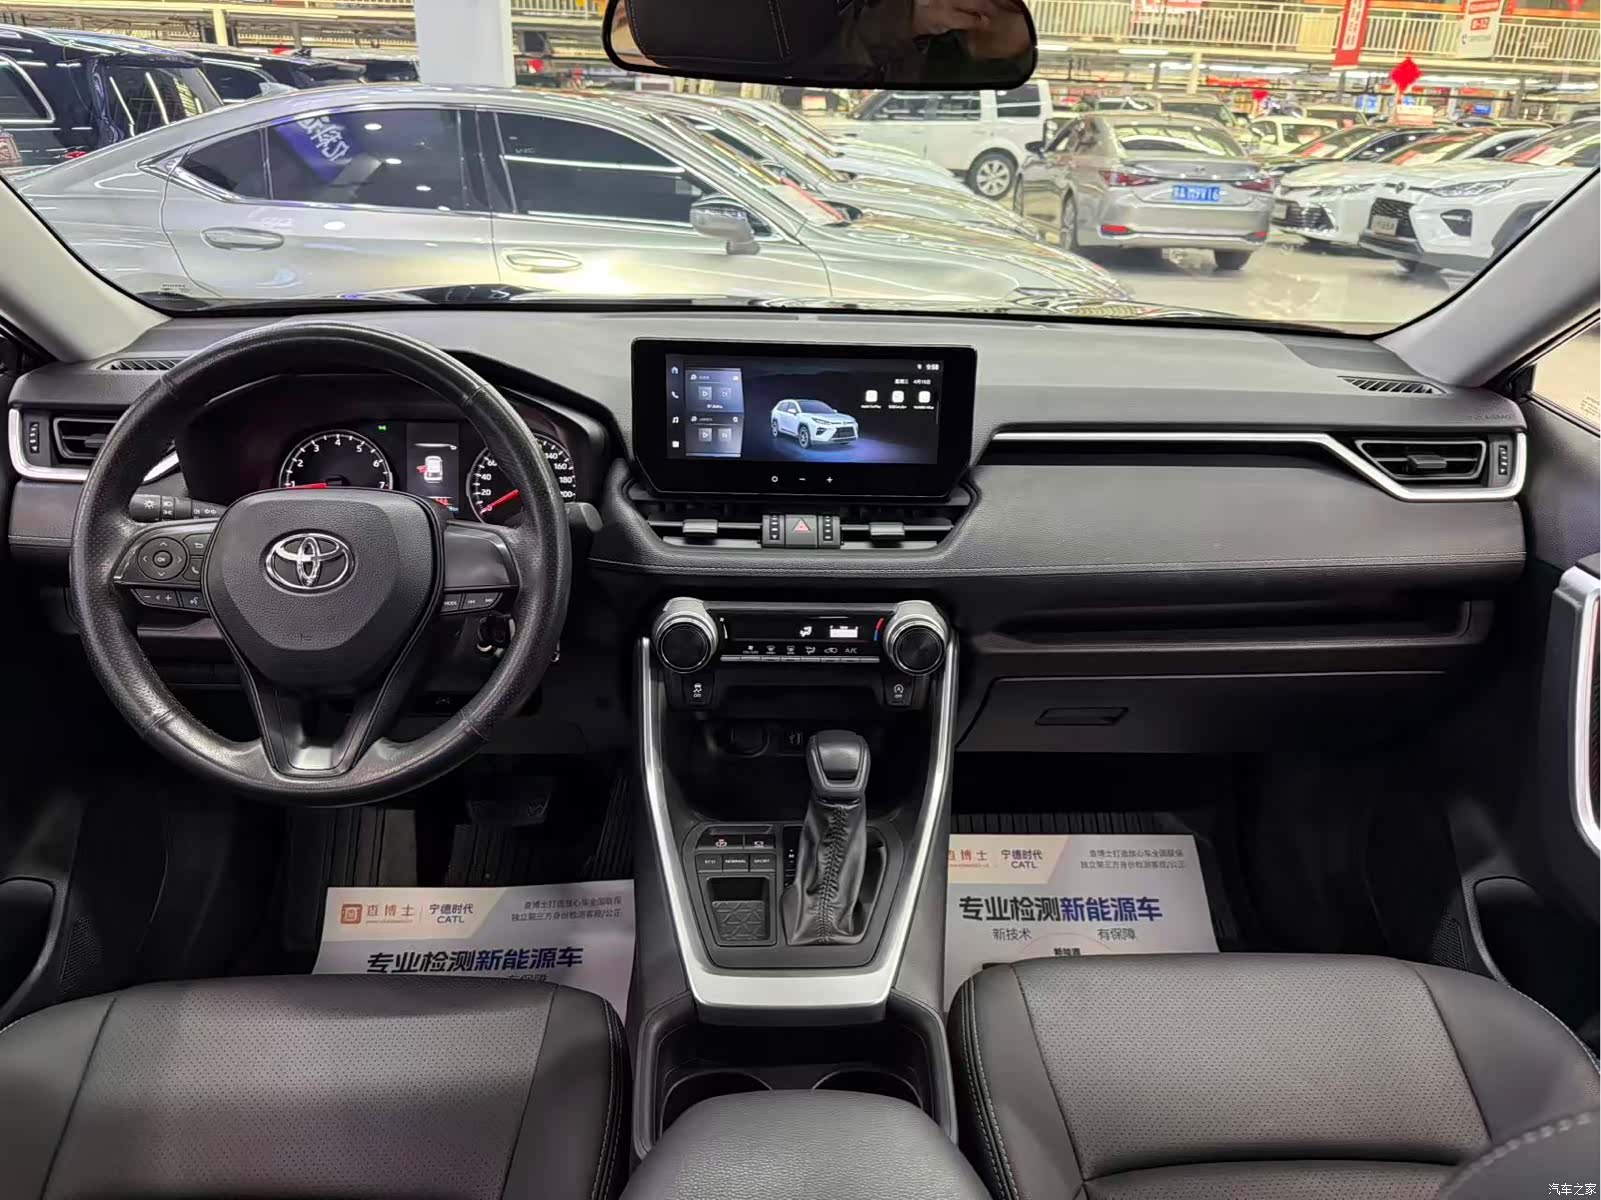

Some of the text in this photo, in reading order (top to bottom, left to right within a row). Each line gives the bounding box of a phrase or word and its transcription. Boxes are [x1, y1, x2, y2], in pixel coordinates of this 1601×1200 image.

[297, 459, 304, 467] 2
[373, 460, 380, 468] 6
[481, 473, 492, 481] 40
[379, 481, 385, 489] 7
[1001, 849, 1043, 860] 宁德时代
[1011, 861, 1037, 869] CATL
[429, 903, 474, 915] 宁德时代
[959, 896, 1163, 922] 专业检测新能源车
[437, 915, 465, 924] CATL
[992, 928, 1032, 941] 新技术
[1097, 928, 1137, 941] 有保障
[367, 946, 584, 974] 专业检测新能源车
